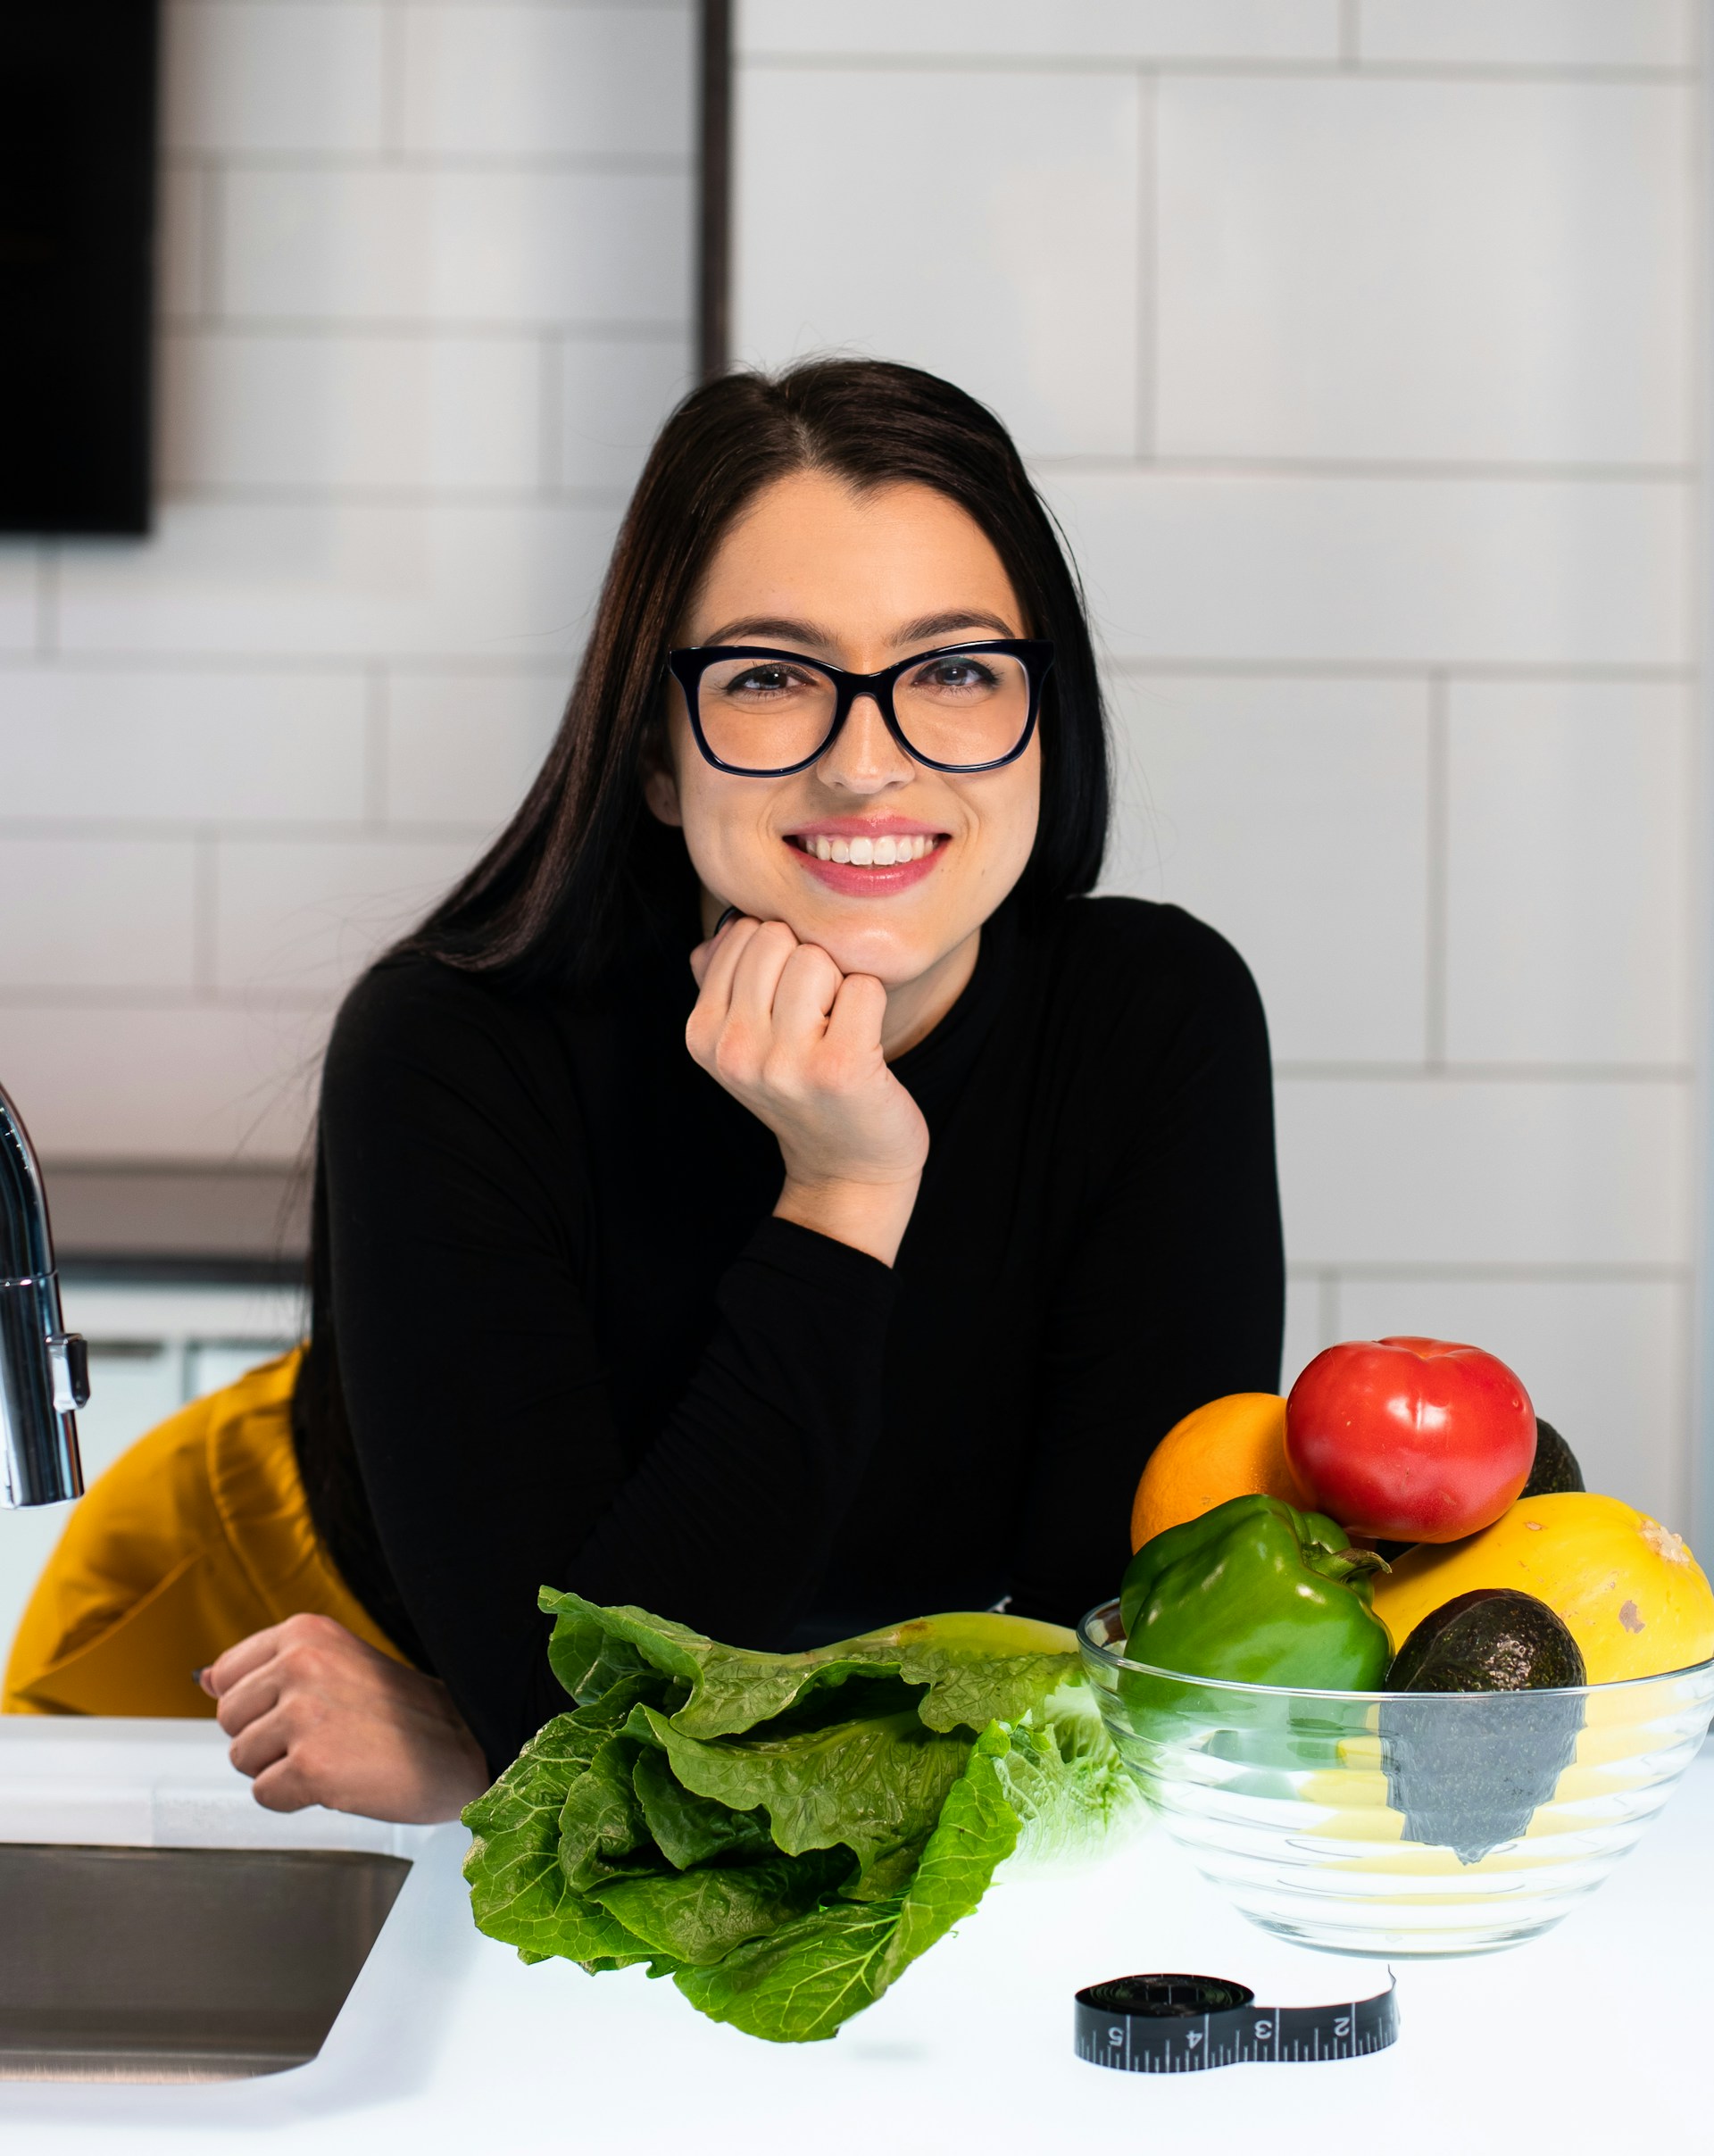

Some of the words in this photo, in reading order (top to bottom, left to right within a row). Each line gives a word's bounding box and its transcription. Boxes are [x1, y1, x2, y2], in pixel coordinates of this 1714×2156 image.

[1108, 2027, 1125, 2047] 5
[1254, 2019, 1273, 2040] 3
[1334, 2017, 1351, 2037] 2
[1186, 2030, 1203, 2050] 4
